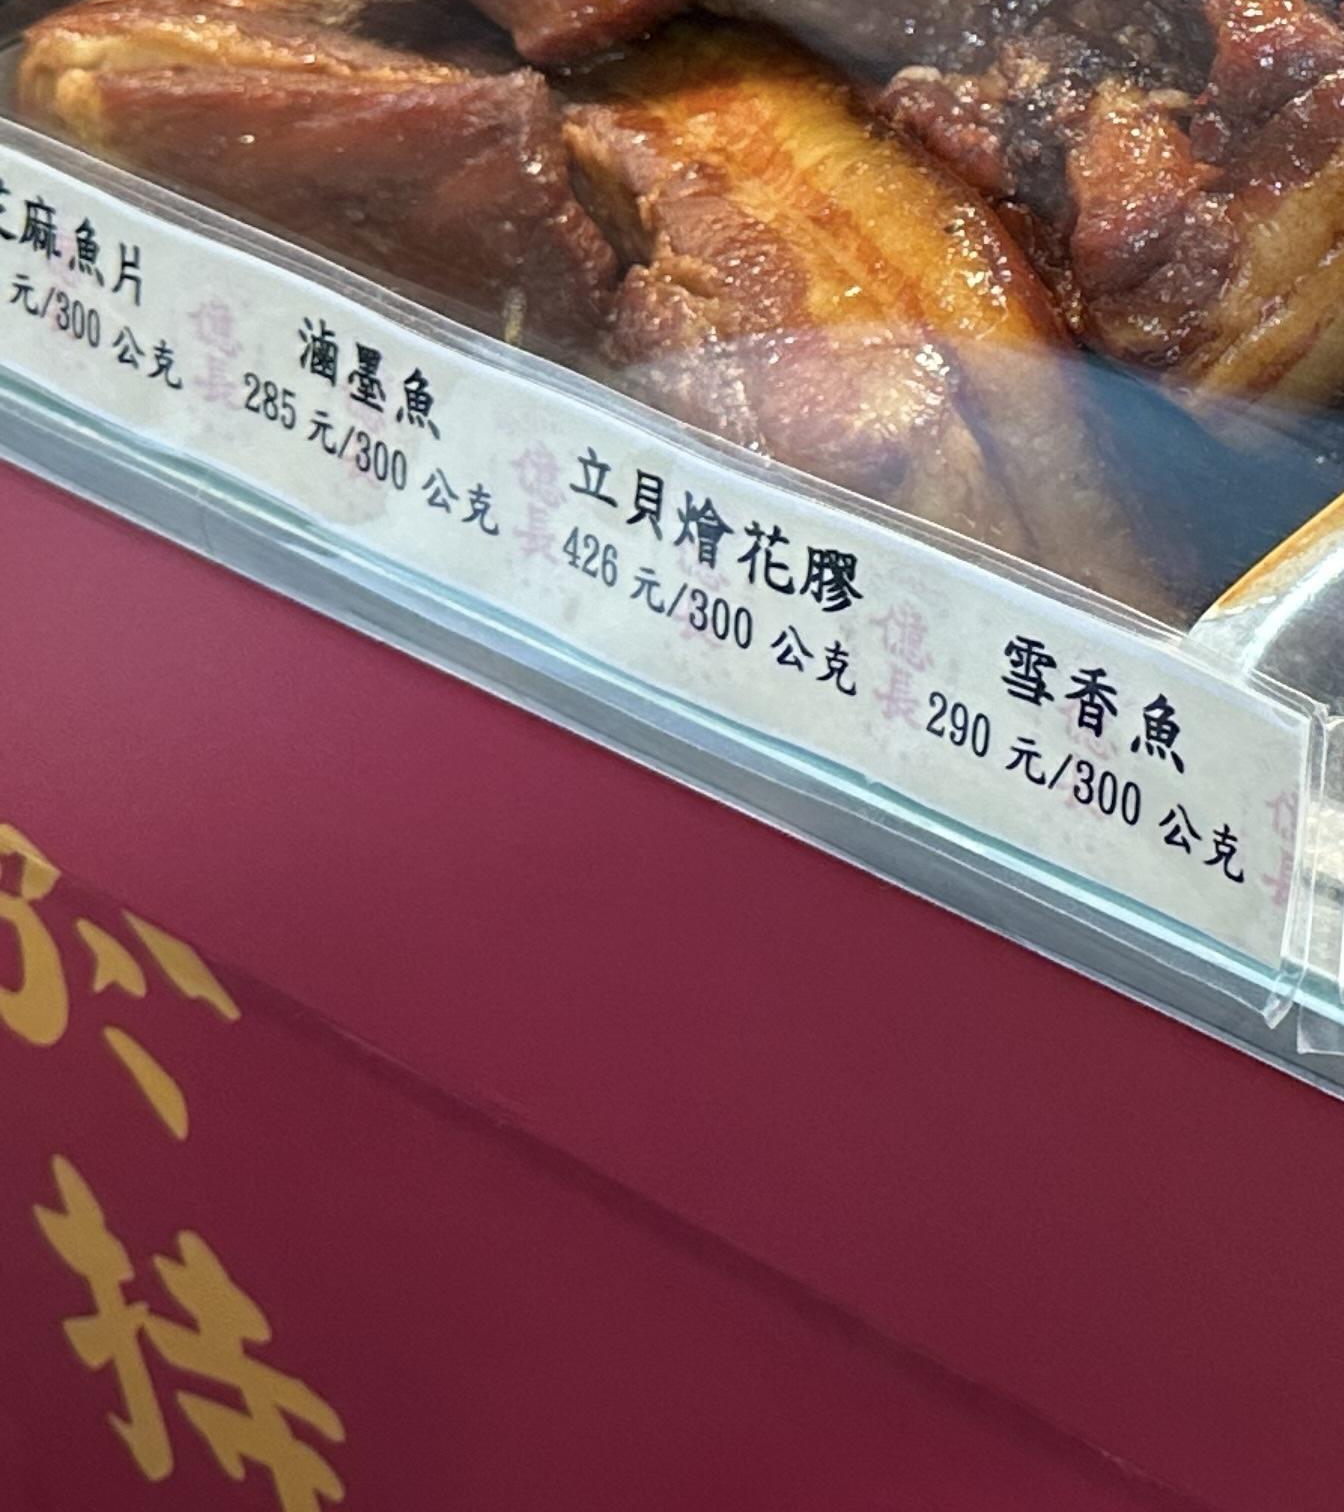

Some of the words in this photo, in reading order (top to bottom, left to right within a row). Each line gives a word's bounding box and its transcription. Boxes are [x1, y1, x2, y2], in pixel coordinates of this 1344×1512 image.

[10, 274, 100, 348] 元/300
[112, 326, 182, 389] 公克
[298, 316, 441, 440] 滷墨魚
[244, 372, 296, 430] 285
[307, 410, 407, 491] 元/300
[422, 468, 499, 535] 公克
[569, 446, 864, 613] 立貝燴花膠
[562, 526, 618, 587] 426
[630, 567, 753, 649] 元/300
[771, 625, 857, 696] 公克
[1001, 634, 1186, 775] 雪香魚
[926, 692, 991, 757] 290
[1004, 736, 1142, 826] 元/300
[1158, 804, 1245, 883] 公克
